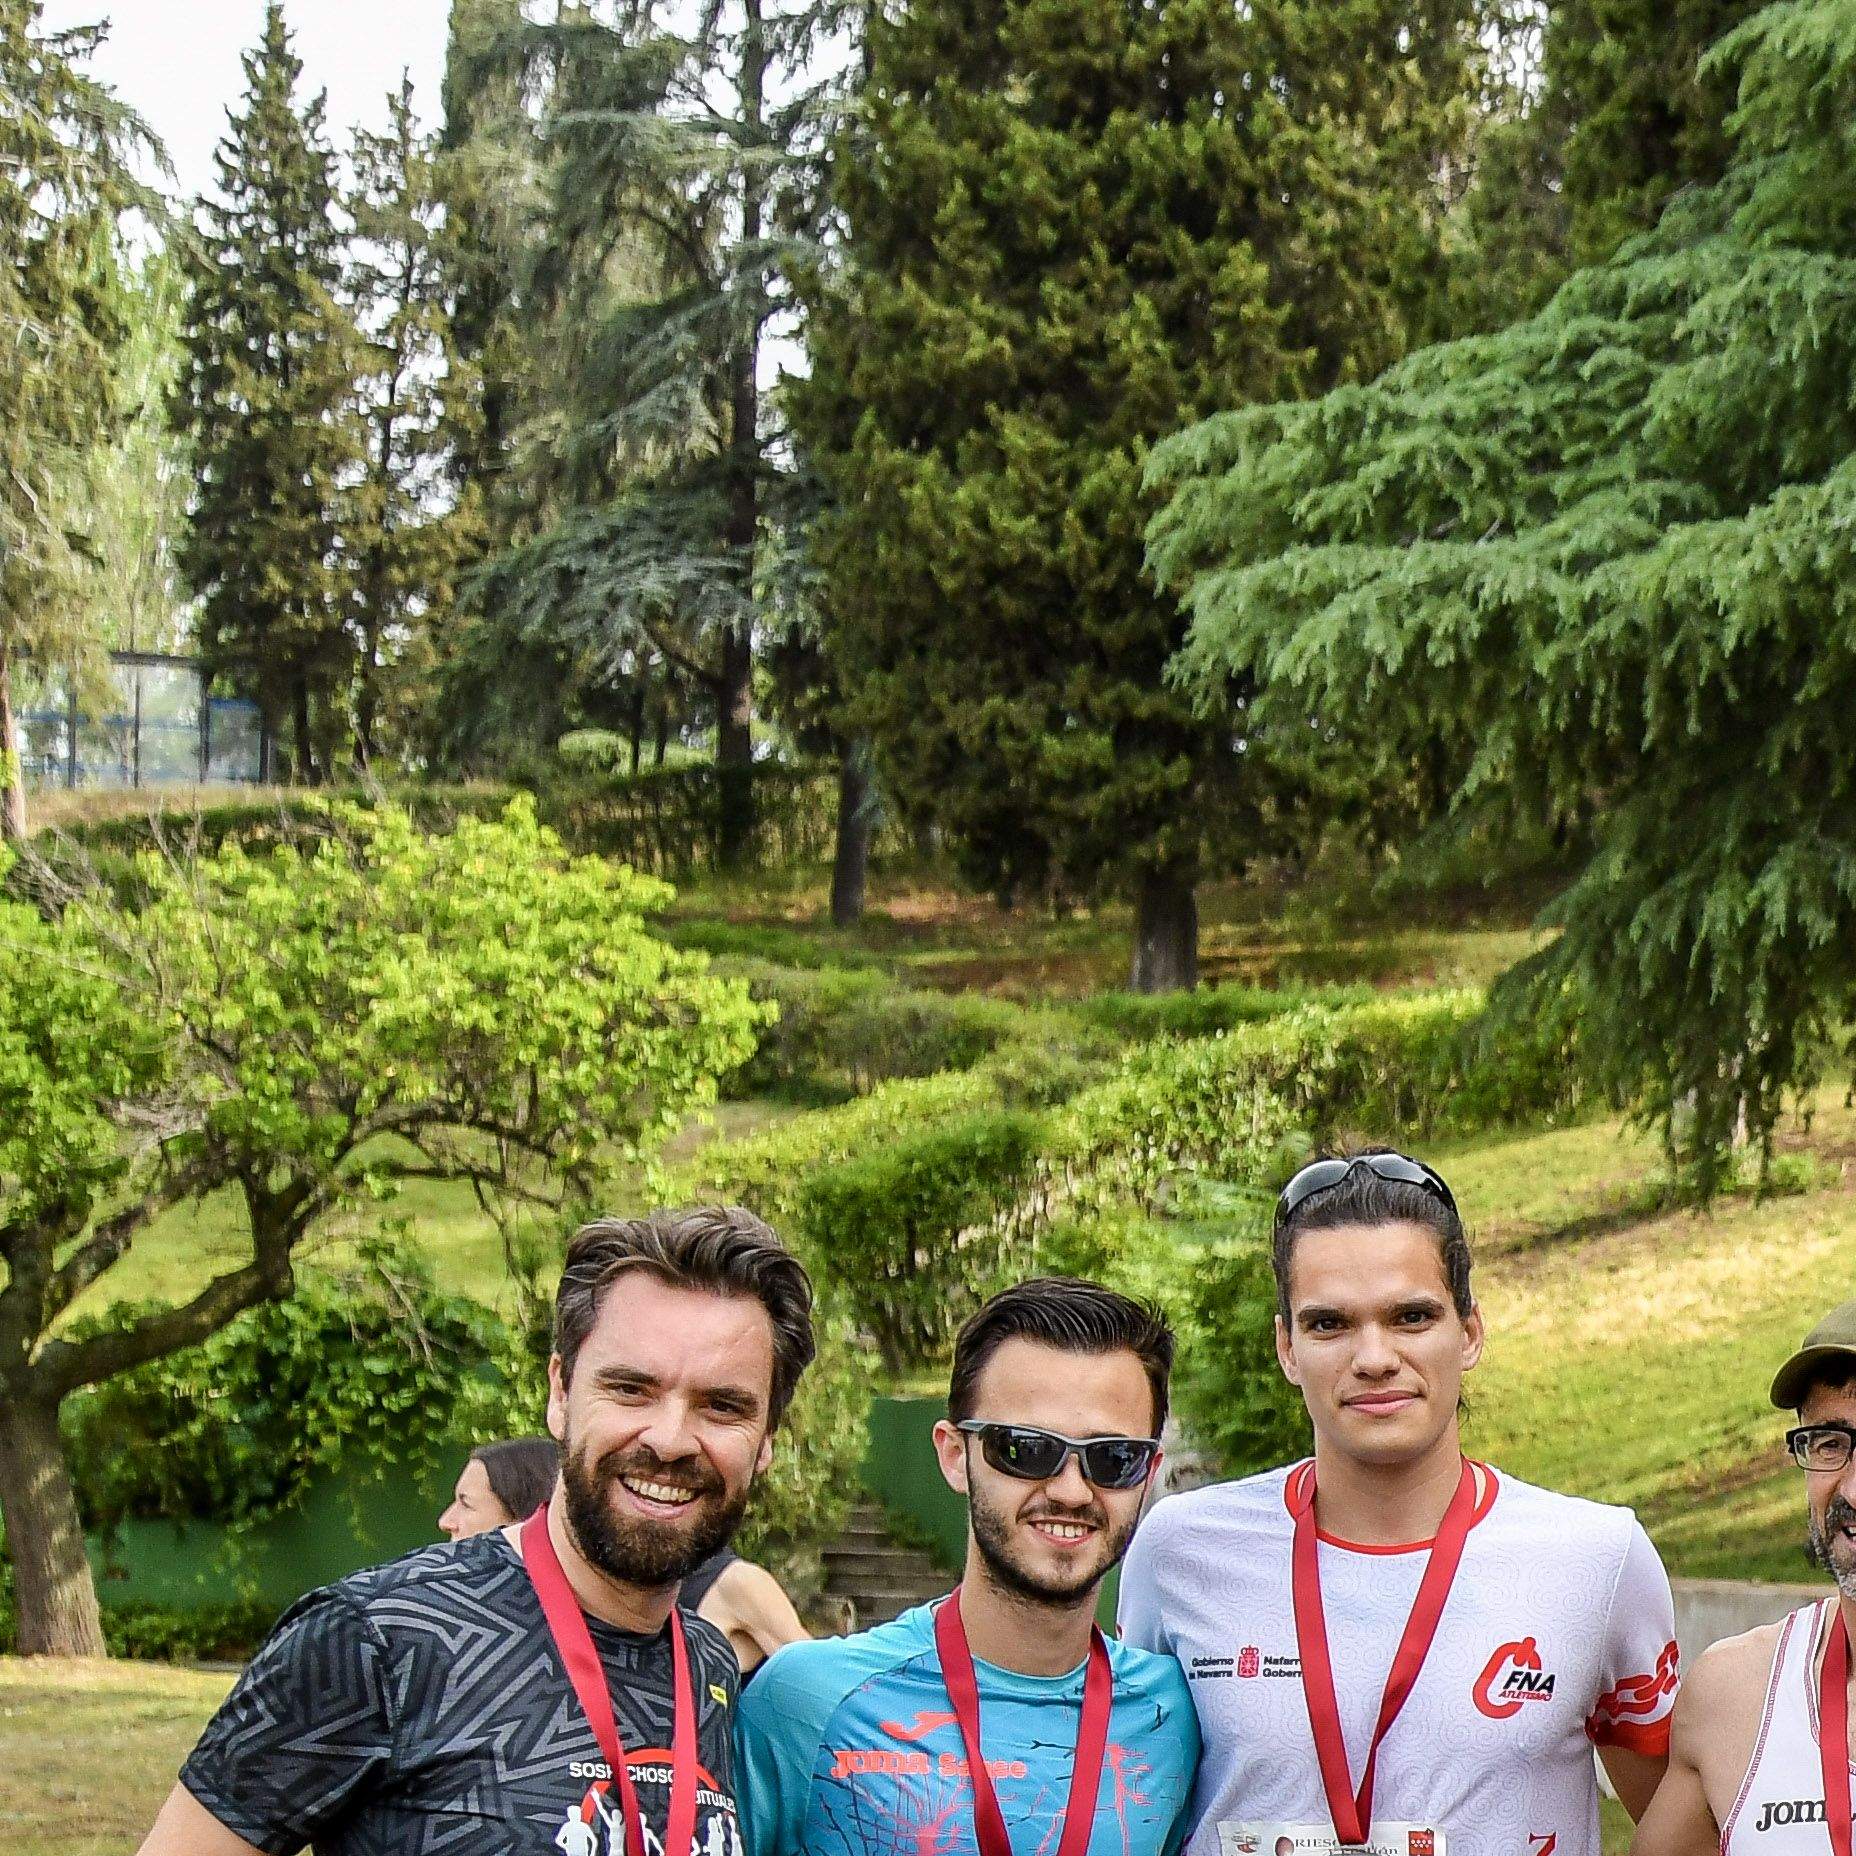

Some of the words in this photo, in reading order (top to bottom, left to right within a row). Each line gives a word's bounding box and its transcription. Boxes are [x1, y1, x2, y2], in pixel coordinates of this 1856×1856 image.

[1263, 1656, 1301, 1666] Nafarr
[1262, 1668, 1302, 1678] Gobern
[1503, 1671, 1556, 1694] FNA
[1295, 1838, 1336, 1848] RIES
